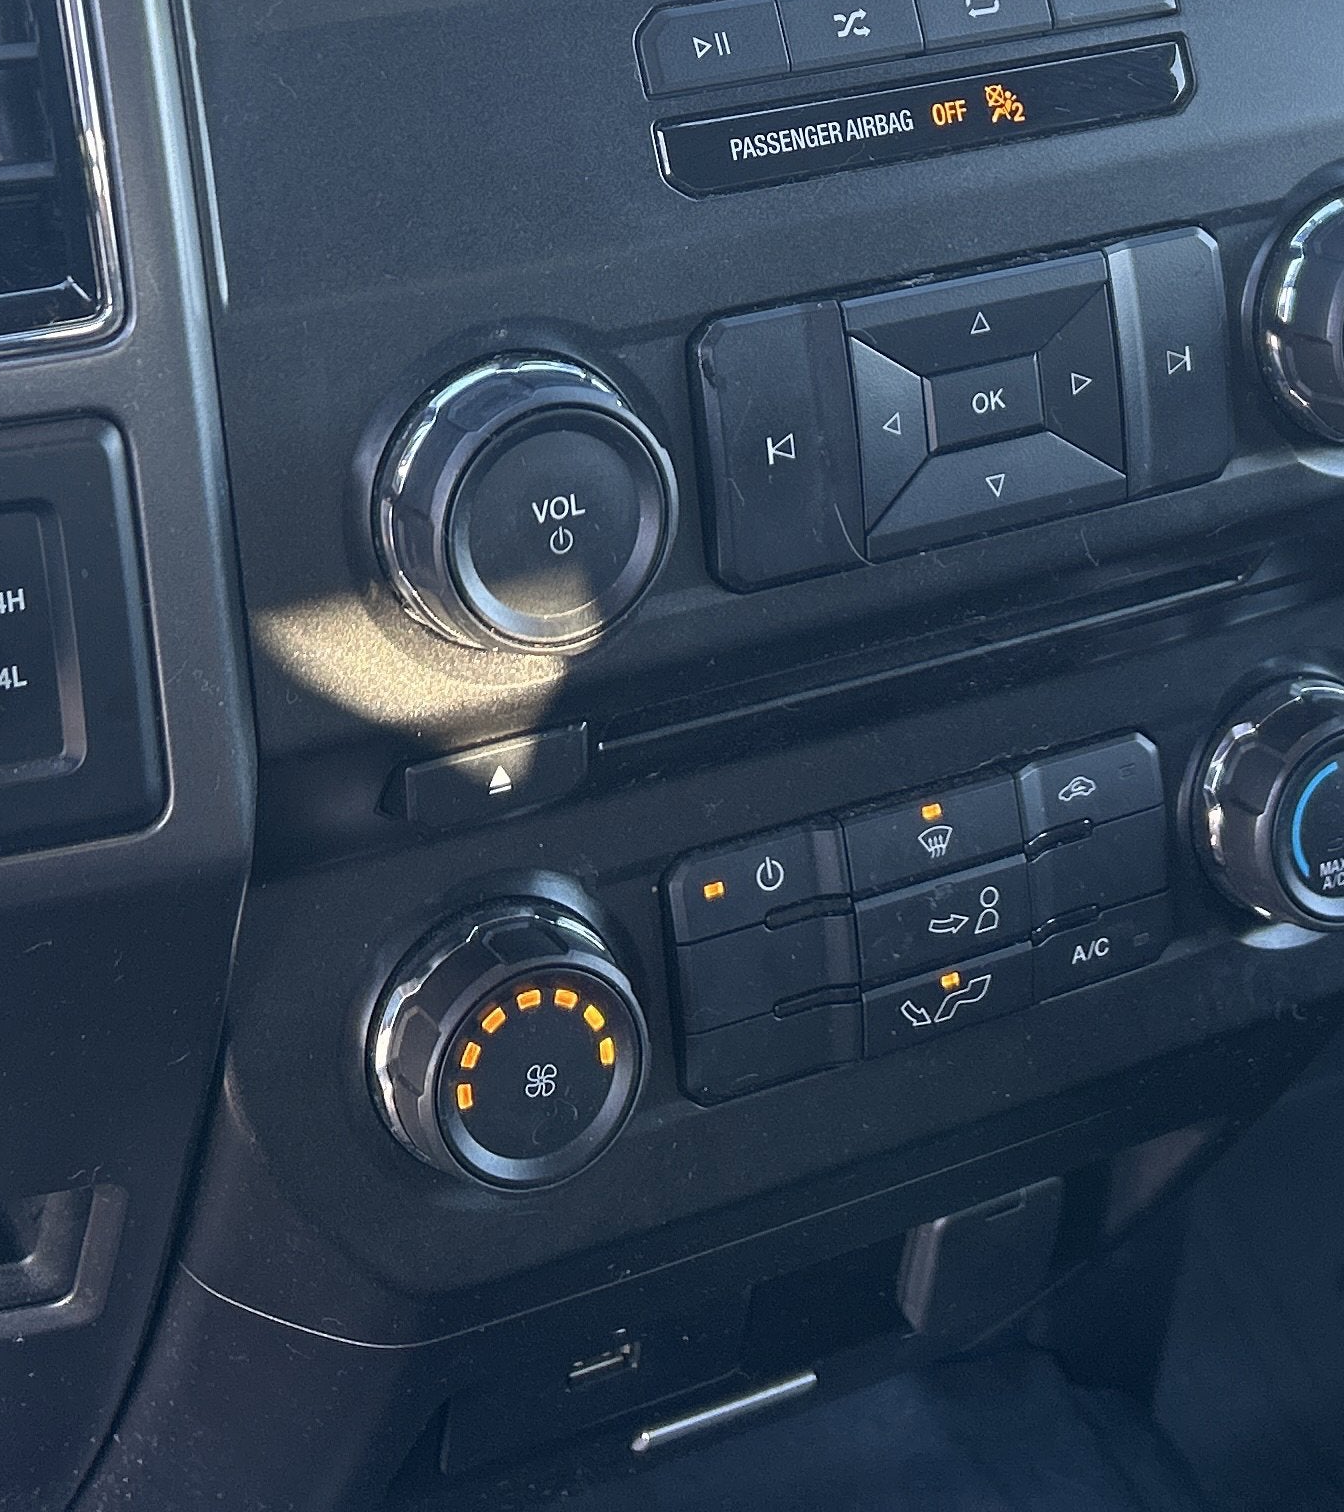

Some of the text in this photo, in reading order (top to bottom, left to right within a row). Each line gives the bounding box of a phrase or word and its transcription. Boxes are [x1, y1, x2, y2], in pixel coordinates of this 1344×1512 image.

[729, 99, 968, 161] PASSENGER AIRBAG OFF
[972, 387, 1006, 414] OK
[531, 493, 586, 524] VOL
[1071, 937, 1110, 965] A/C
